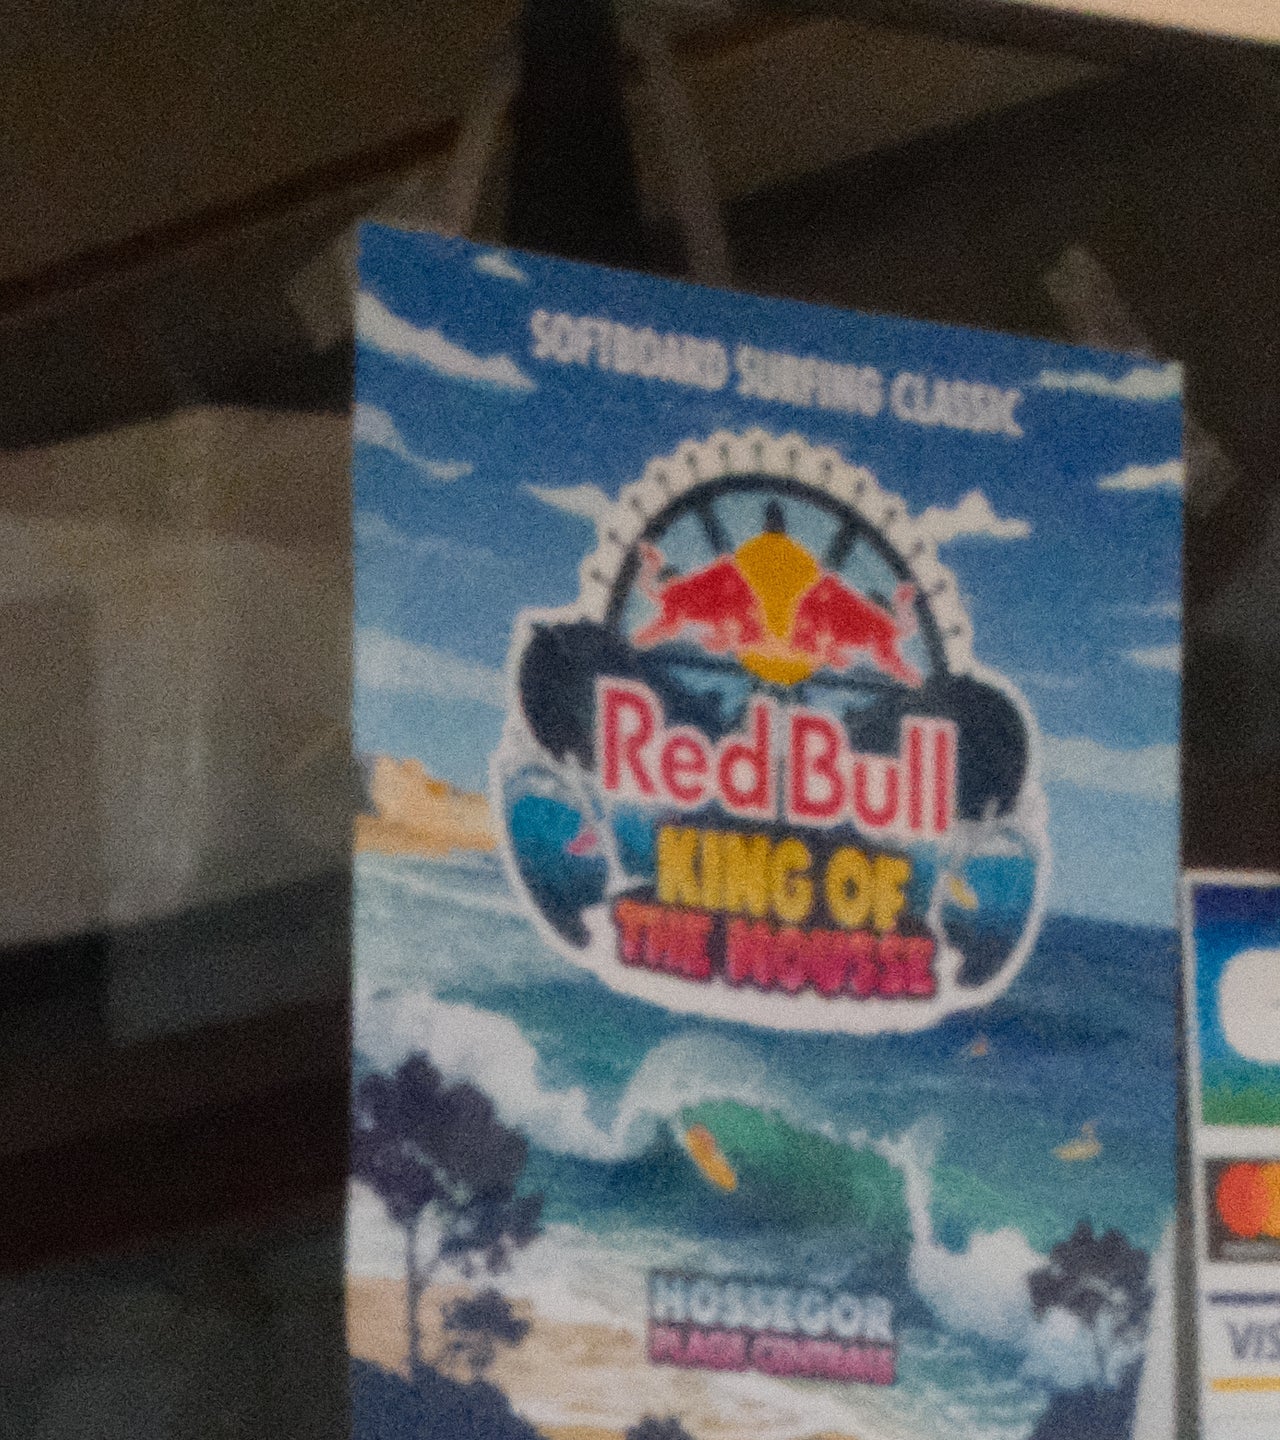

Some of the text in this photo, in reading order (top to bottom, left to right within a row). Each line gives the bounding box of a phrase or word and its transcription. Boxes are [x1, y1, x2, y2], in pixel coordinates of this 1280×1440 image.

[602, 685, 948, 837] Red Bull
[655, 825, 912, 932] KING OF
[651, 1274, 893, 1342] HOSSEGOR
